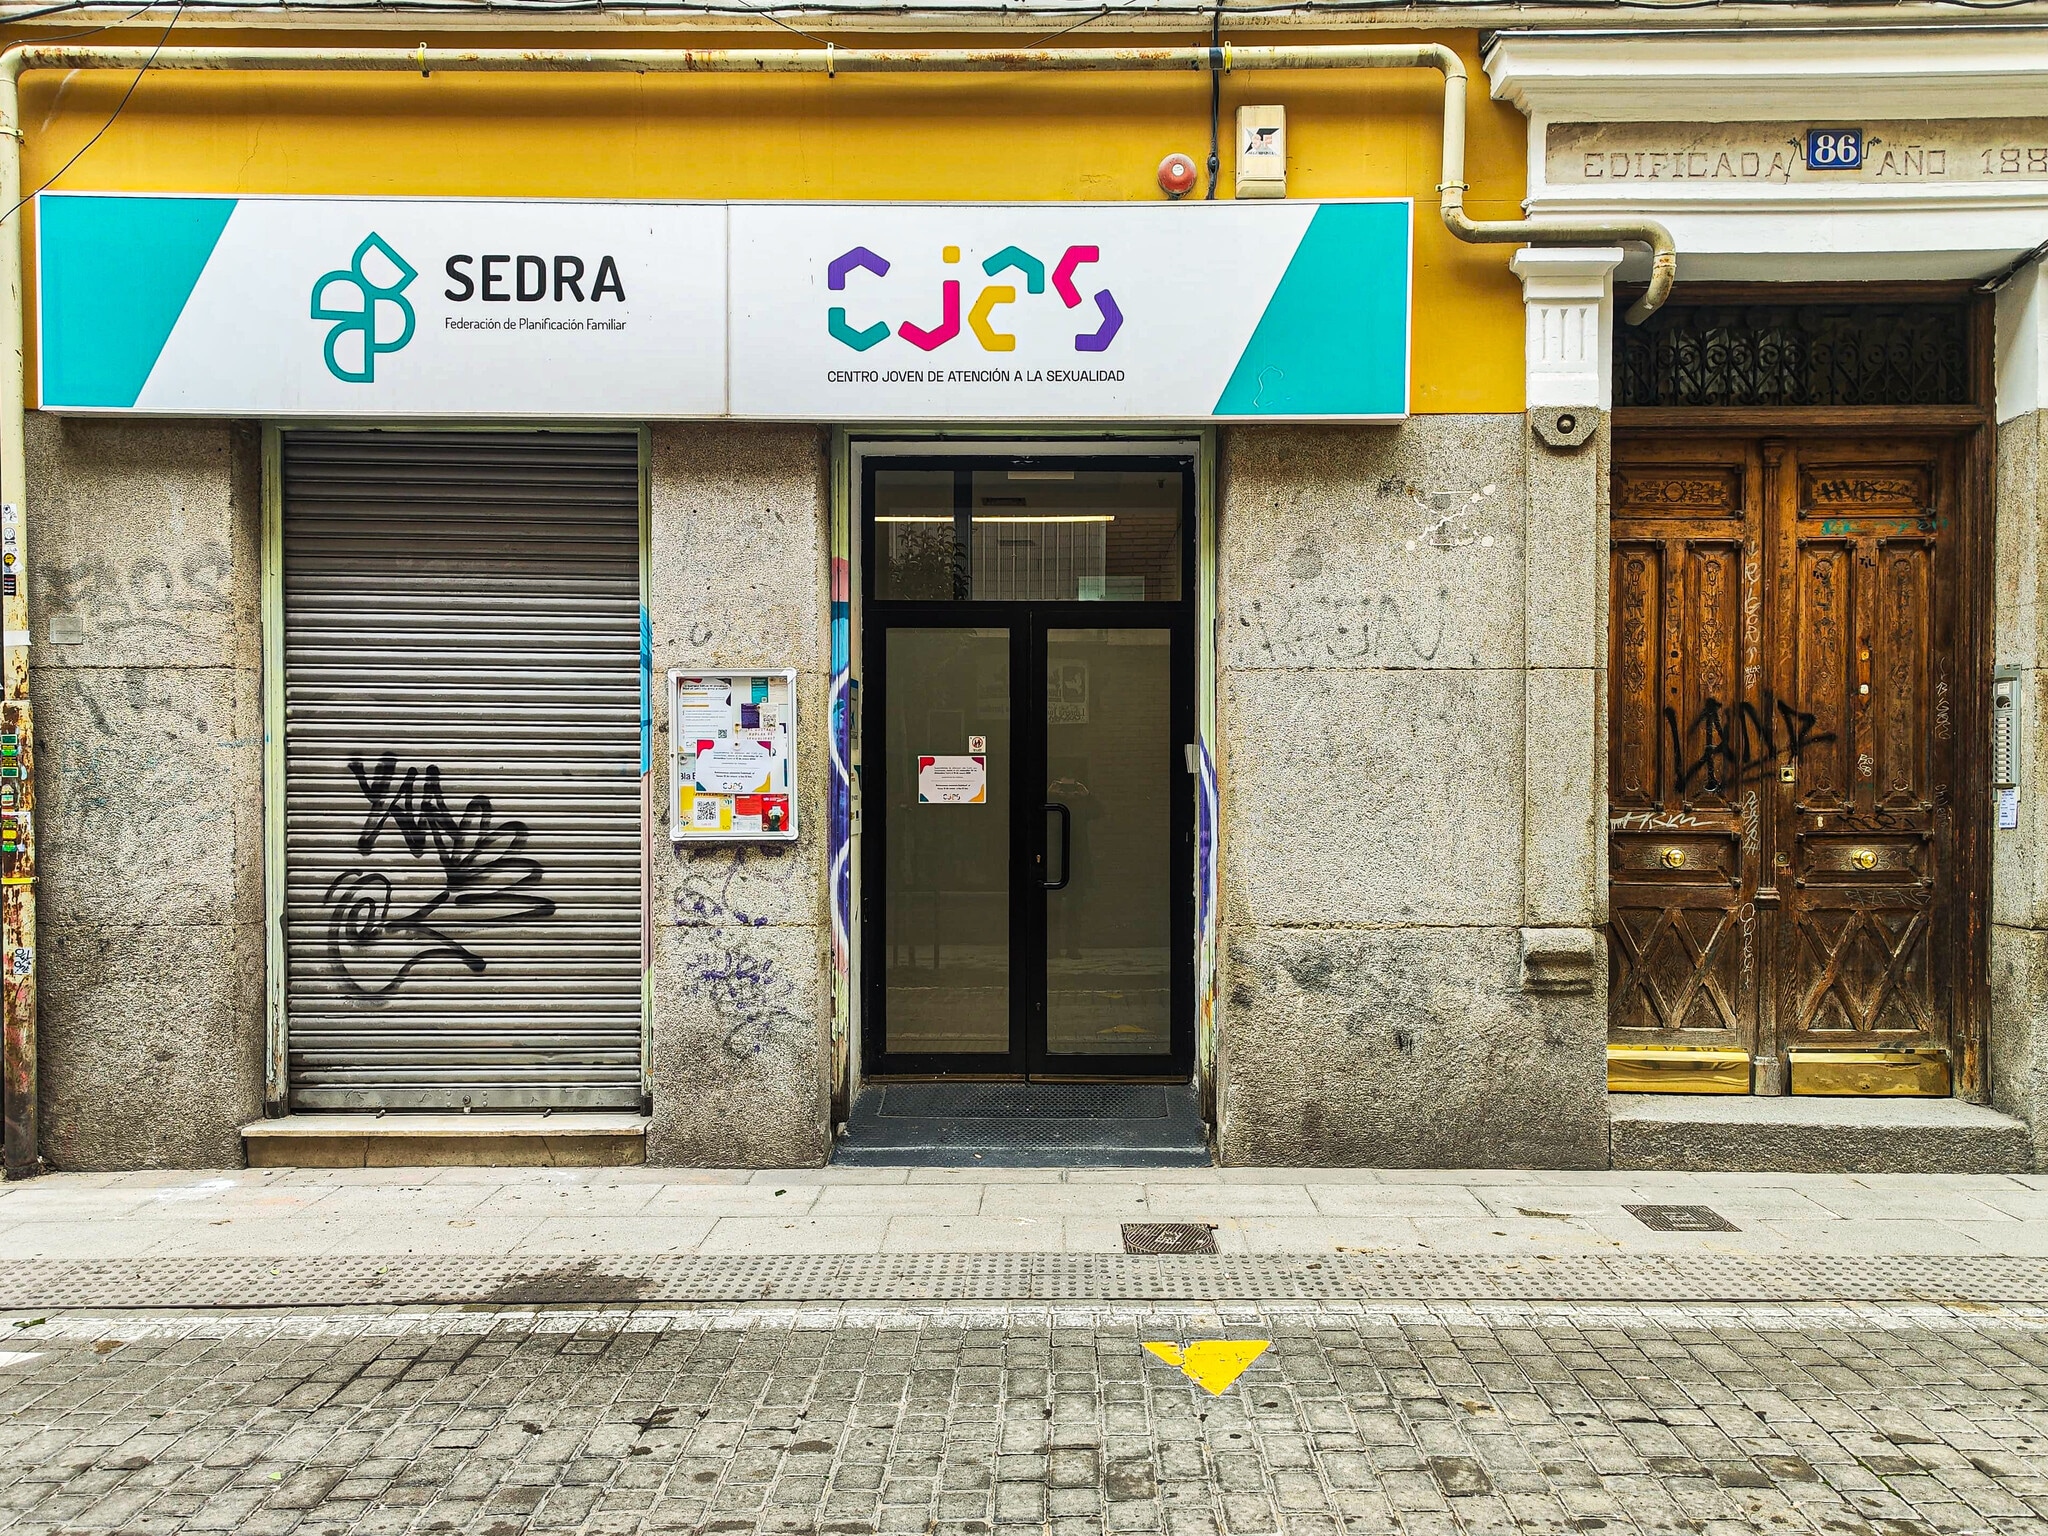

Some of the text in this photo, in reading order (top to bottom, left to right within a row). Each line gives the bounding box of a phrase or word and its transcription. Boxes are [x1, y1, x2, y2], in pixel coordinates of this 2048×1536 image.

[1584, 152, 1791, 179] EDIFICADA
[1876, 145, 1946, 176] AÑO
[1815, 134, 1858, 164] 86
[444, 254, 626, 303] SEDRA
[445, 317, 627, 331] Federación de Planificación Familiar
[827, 367, 1125, 383] CENTRO JOVEN DE ATENCIÓN A LA SEXUALIDAD
